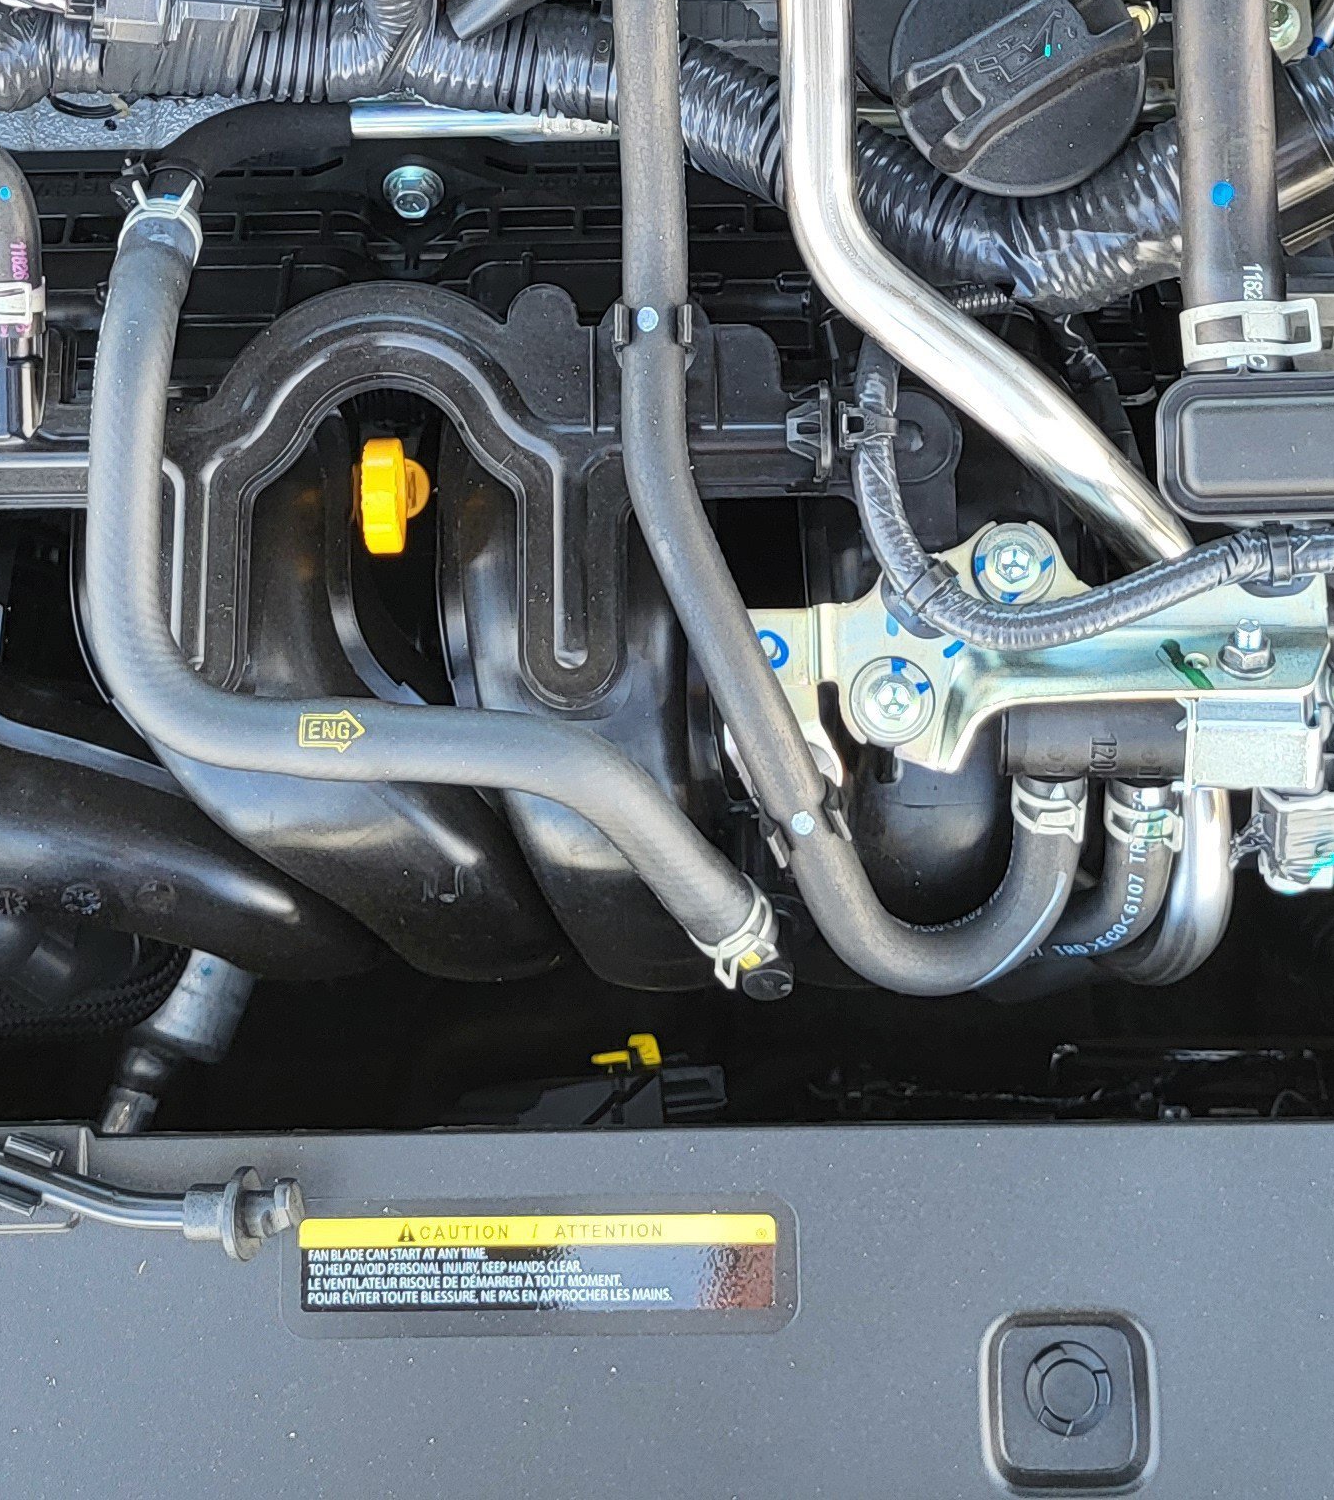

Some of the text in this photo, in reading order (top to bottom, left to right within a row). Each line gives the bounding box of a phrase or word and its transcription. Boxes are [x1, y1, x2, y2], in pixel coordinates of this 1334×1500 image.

[308, 721, 350, 739] ENG
[420, 1225, 508, 1240] CAUTION
[555, 1224, 662, 1238] ATTENTION
[308, 1249, 488, 1261] FAN BLADE CAN START AT ANY TIME.
[308, 1262, 323, 1275] TO
[325, 1262, 351, 1275] HELP
[353, 1262, 385, 1275] AVOID
[388, 1262, 440, 1275] PERSONAL
[442, 1262, 480, 1275] INJURY,
[481, 1262, 506, 1275] KEEP
[508, 1262, 546, 1275] HANDS
[308, 1274, 622, 1289] LE VENTILATEUR RISQUE DE DÉMARRER À TOUT MOMENT.
[308, 1289, 672, 1306] POUR ÉVITER TOUTE BLESSURE, NE PAS EN APPROCHER LES MAINS.
